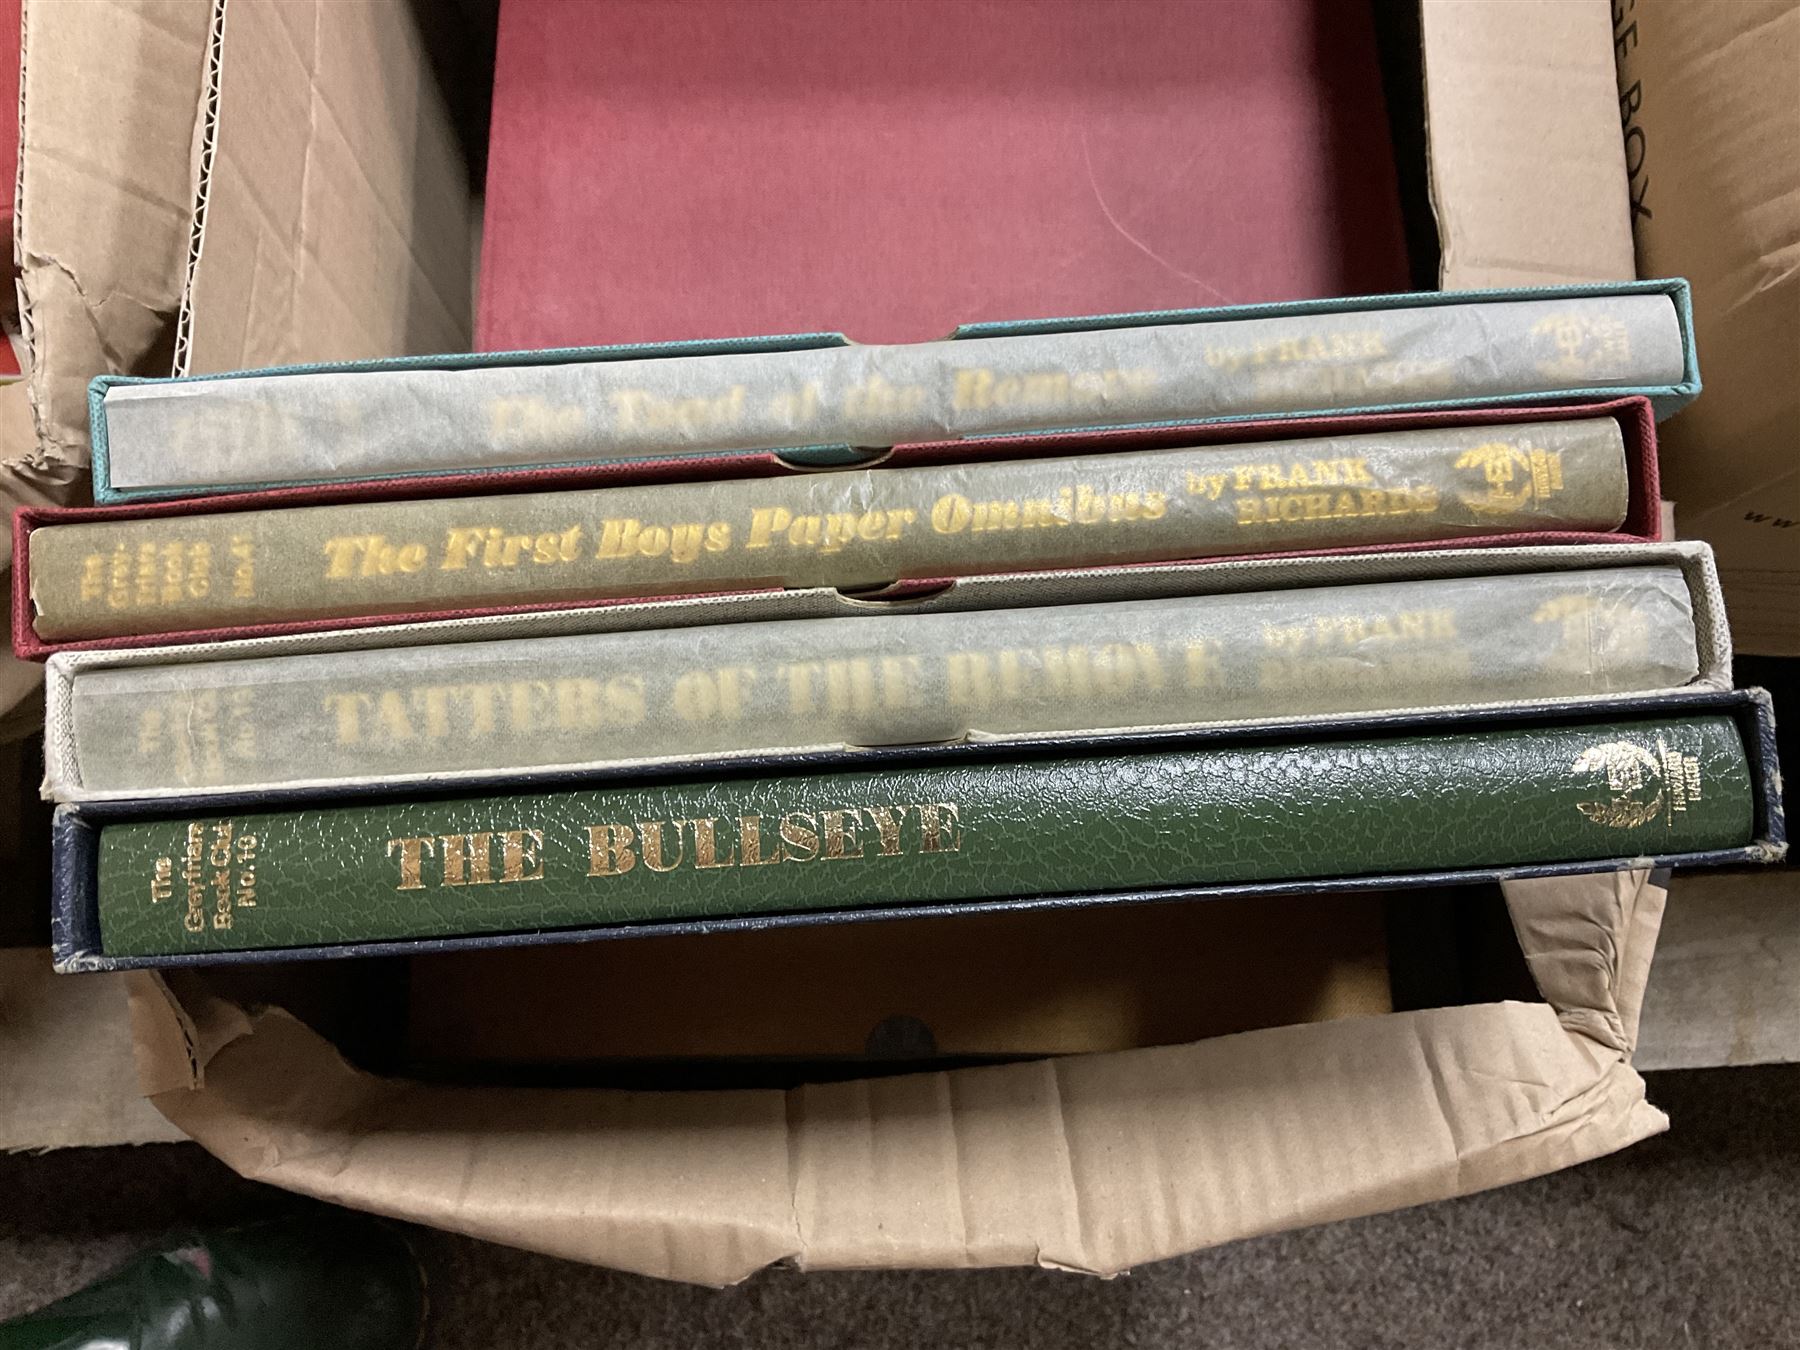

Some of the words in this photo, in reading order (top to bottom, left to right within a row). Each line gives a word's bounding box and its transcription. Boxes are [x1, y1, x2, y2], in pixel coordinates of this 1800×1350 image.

[1621, 79, 1653, 230] BOX
[1186, 471, 1228, 500] by
[1234, 458, 1372, 491] FRANK
[1238, 486, 1439, 524] RICHARDS
[325, 534, 428, 578] The
[441, 524, 583, 570] First
[595, 518, 732, 563] Boys
[745, 506, 917, 553] Paper
[930, 484, 1170, 534] Omnibus
[1314, 610, 1457, 645] FRANK
[325, 674, 647, 743] TATTERS
[673, 668, 756, 722] OF
[776, 655, 921, 713] THE
[151, 857, 172, 903] The
[181, 822, 205, 932] Greyfriars
[386, 829, 546, 890] THE
[585, 802, 962, 877] BULLSEYE
[211, 869, 233, 929] Book
